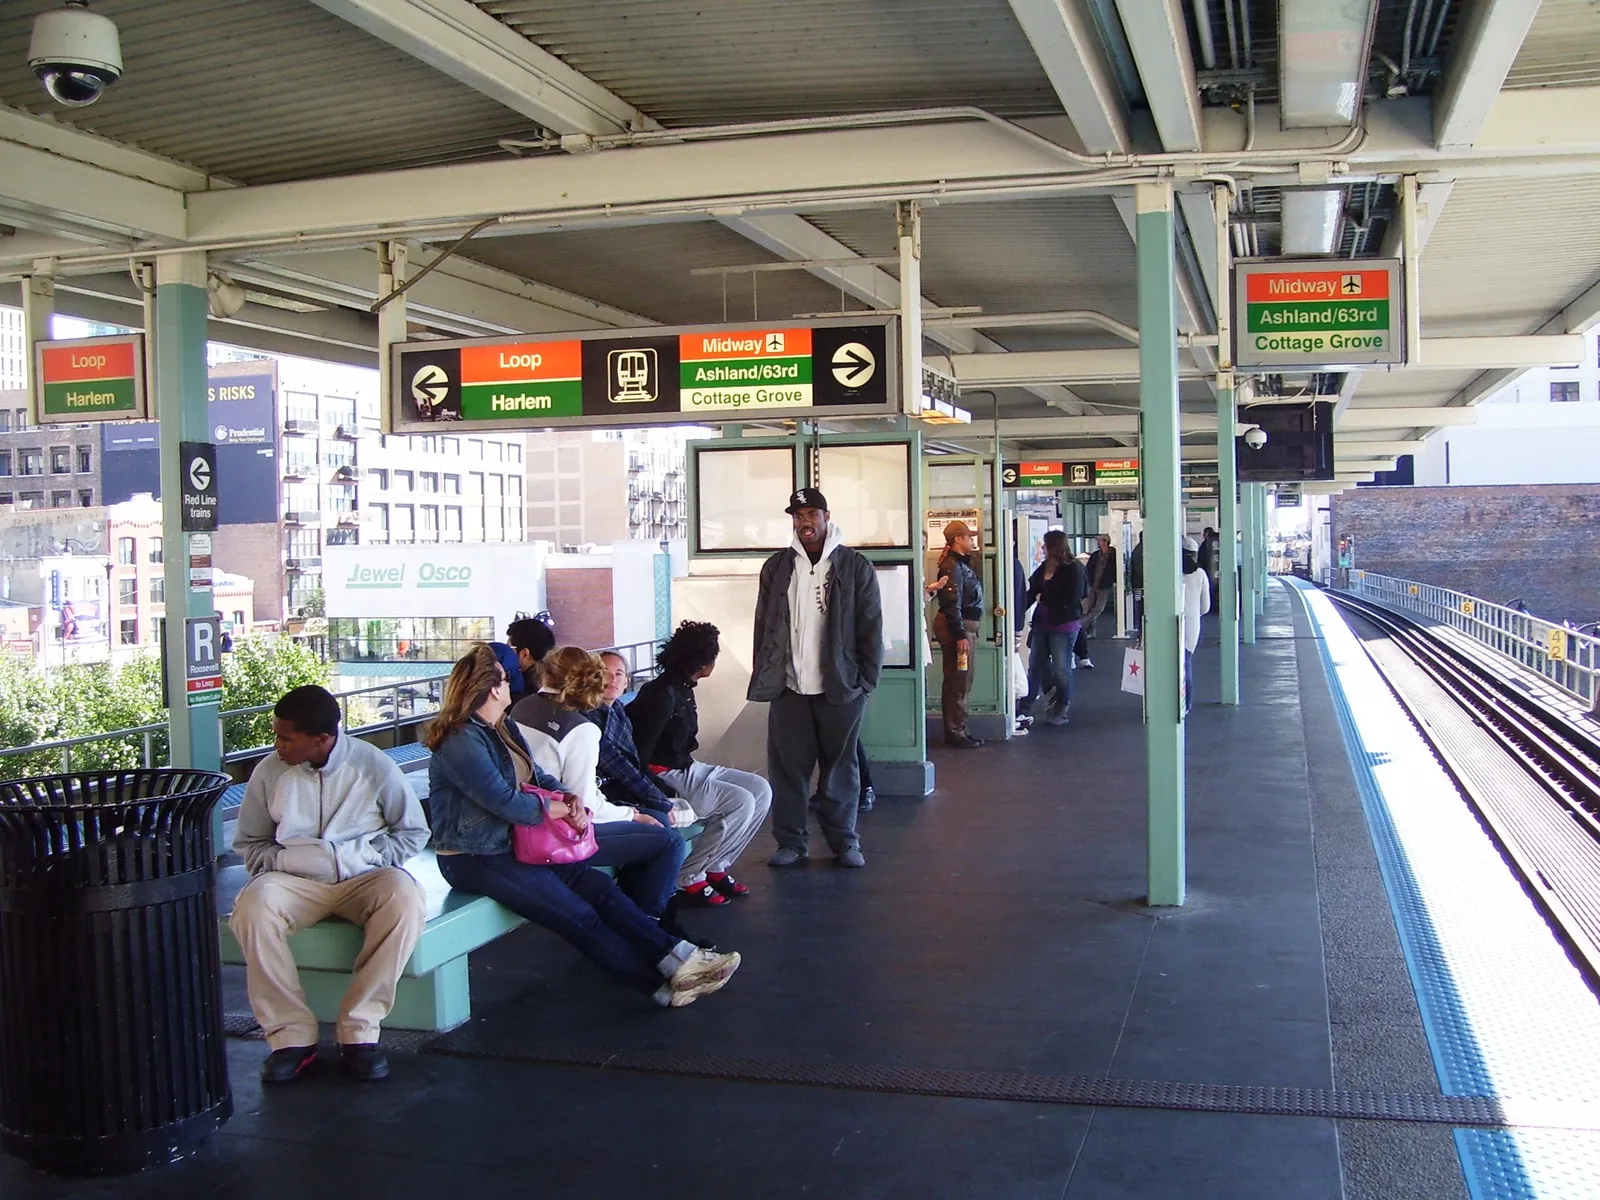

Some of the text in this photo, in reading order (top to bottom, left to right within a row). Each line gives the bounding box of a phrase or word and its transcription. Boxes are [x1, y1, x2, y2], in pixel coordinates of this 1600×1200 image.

[1269, 278, 1337, 297] Midway
[1260, 307, 1378, 325] Ashland/63rd
[702, 336, 764, 356] Midway
[1255, 334, 1383, 352] Cottage Grove
[71, 353, 106, 370] Loop
[499, 351, 542, 371] Loop
[695, 362, 798, 382] Ashland/63rd
[66, 390, 115, 407] Harlem
[219, 385, 256, 401] RISKS
[691, 386, 803, 407] Cottage Grove
[491, 392, 552, 412] Harlem
[229, 428, 265, 437] Prudential
[1033, 464, 1049, 472] Loop
[184, 494, 217, 505] Red Line
[190, 507, 211, 519] trains
[928, 510, 960, 518] Customer
[346, 562, 472, 582] Jewel Osco
[1463, 602, 1470, 612] 6
[194, 622, 214, 662] R
[1552, 630, 1560, 643] 4
[1552, 646, 1561, 659] 2
[190, 663, 219, 674] Roosevelt
[202, 680, 214, 688] Loop
